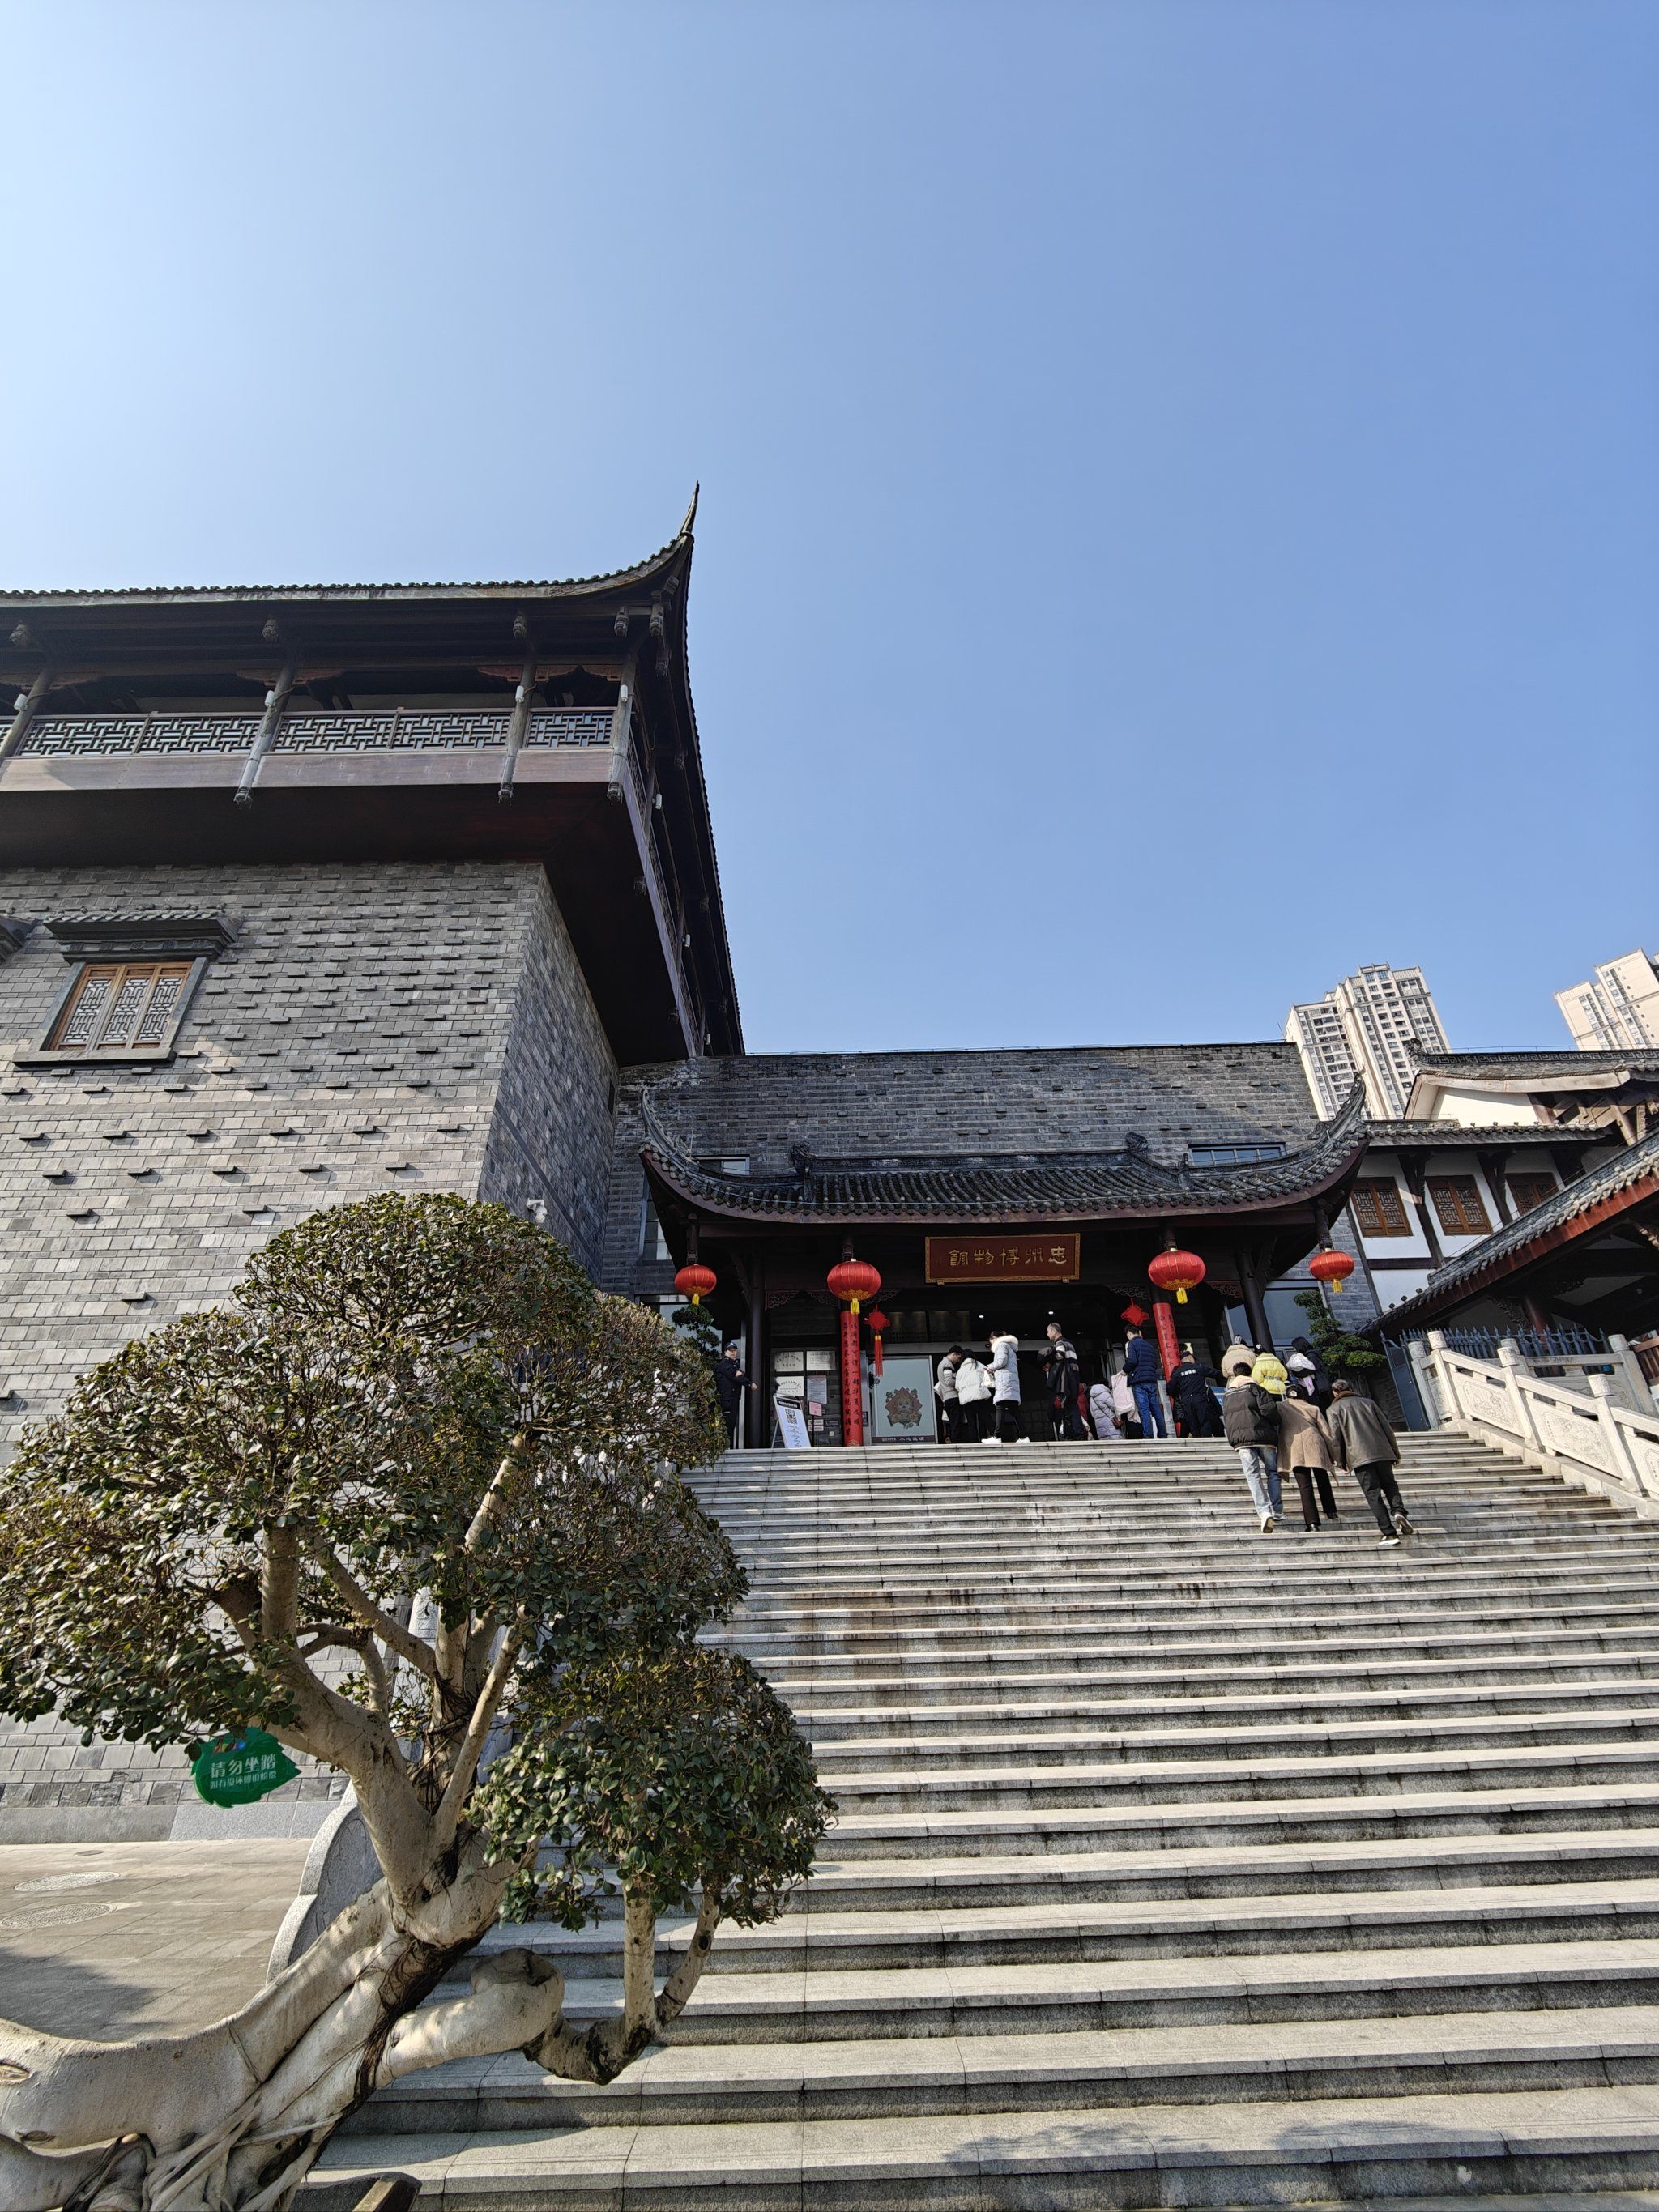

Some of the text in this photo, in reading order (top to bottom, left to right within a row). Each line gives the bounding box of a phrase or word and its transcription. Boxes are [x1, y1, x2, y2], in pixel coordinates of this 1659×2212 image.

[211, 1754, 276, 1778] 请勿坐踏
[210, 1771, 277, 1789] 如有损坏照价赔偿
